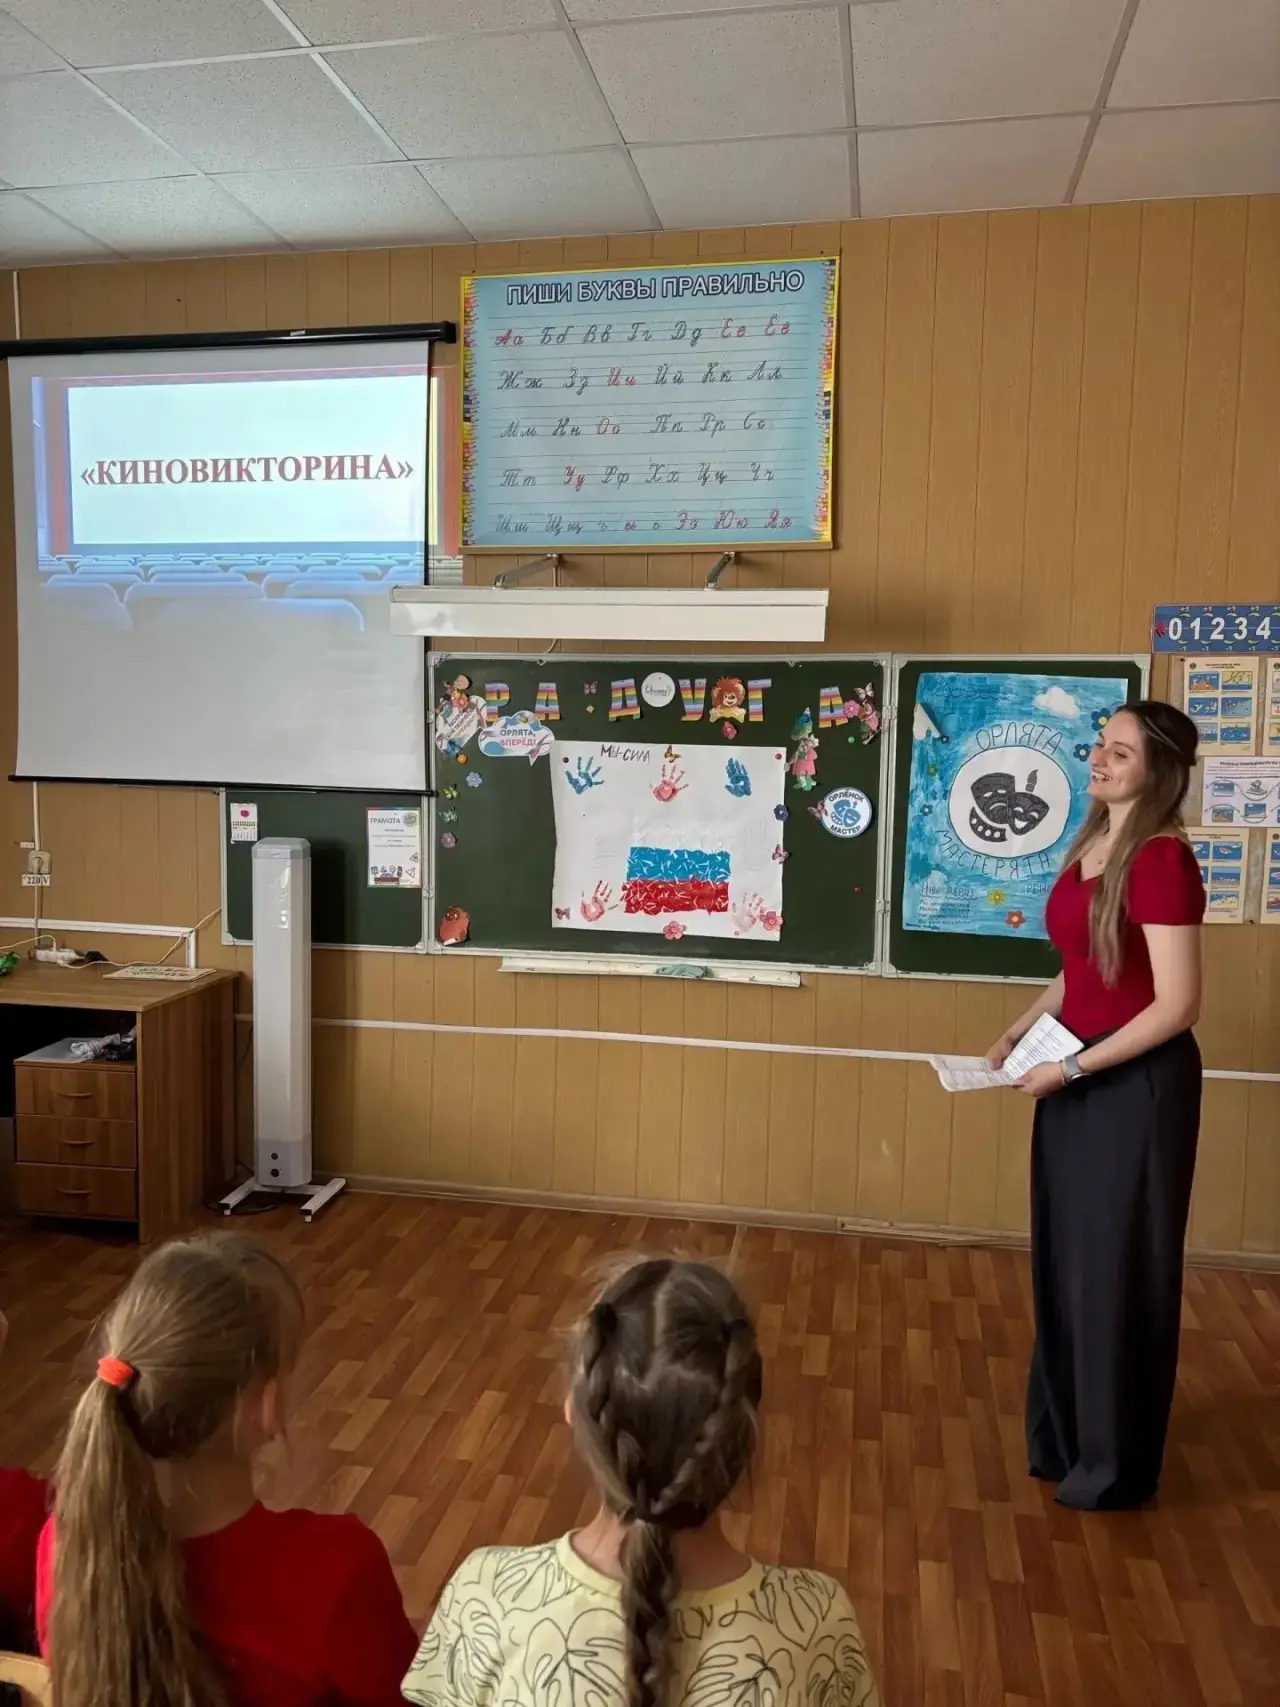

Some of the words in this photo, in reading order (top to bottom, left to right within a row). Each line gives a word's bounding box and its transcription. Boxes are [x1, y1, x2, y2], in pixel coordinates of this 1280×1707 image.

[507, 283, 572, 305] ПИШИ
[577, 278, 656, 302] БУКВЫ
[661, 270, 805, 298] ПРАВИЛЬНО
[80, 453, 415, 486] «КИНОВИКТОРИНА»
[1168, 617, 1182, 640] 0
[1190, 617, 1201, 640] 1
[1209, 617, 1225, 640] 2
[1233, 617, 1248, 640] 3
[1256, 616, 1271, 640] 4
[500, 729, 537, 737] ОРЛЯТА,
[500, 738, 537, 748] ВПЕРЁД!
[975, 722, 1064, 754] ОРЛЯТА
[830, 825, 861, 835] МАСТЕР
[935, 830, 1051, 879] МАСТЕРЯТА
